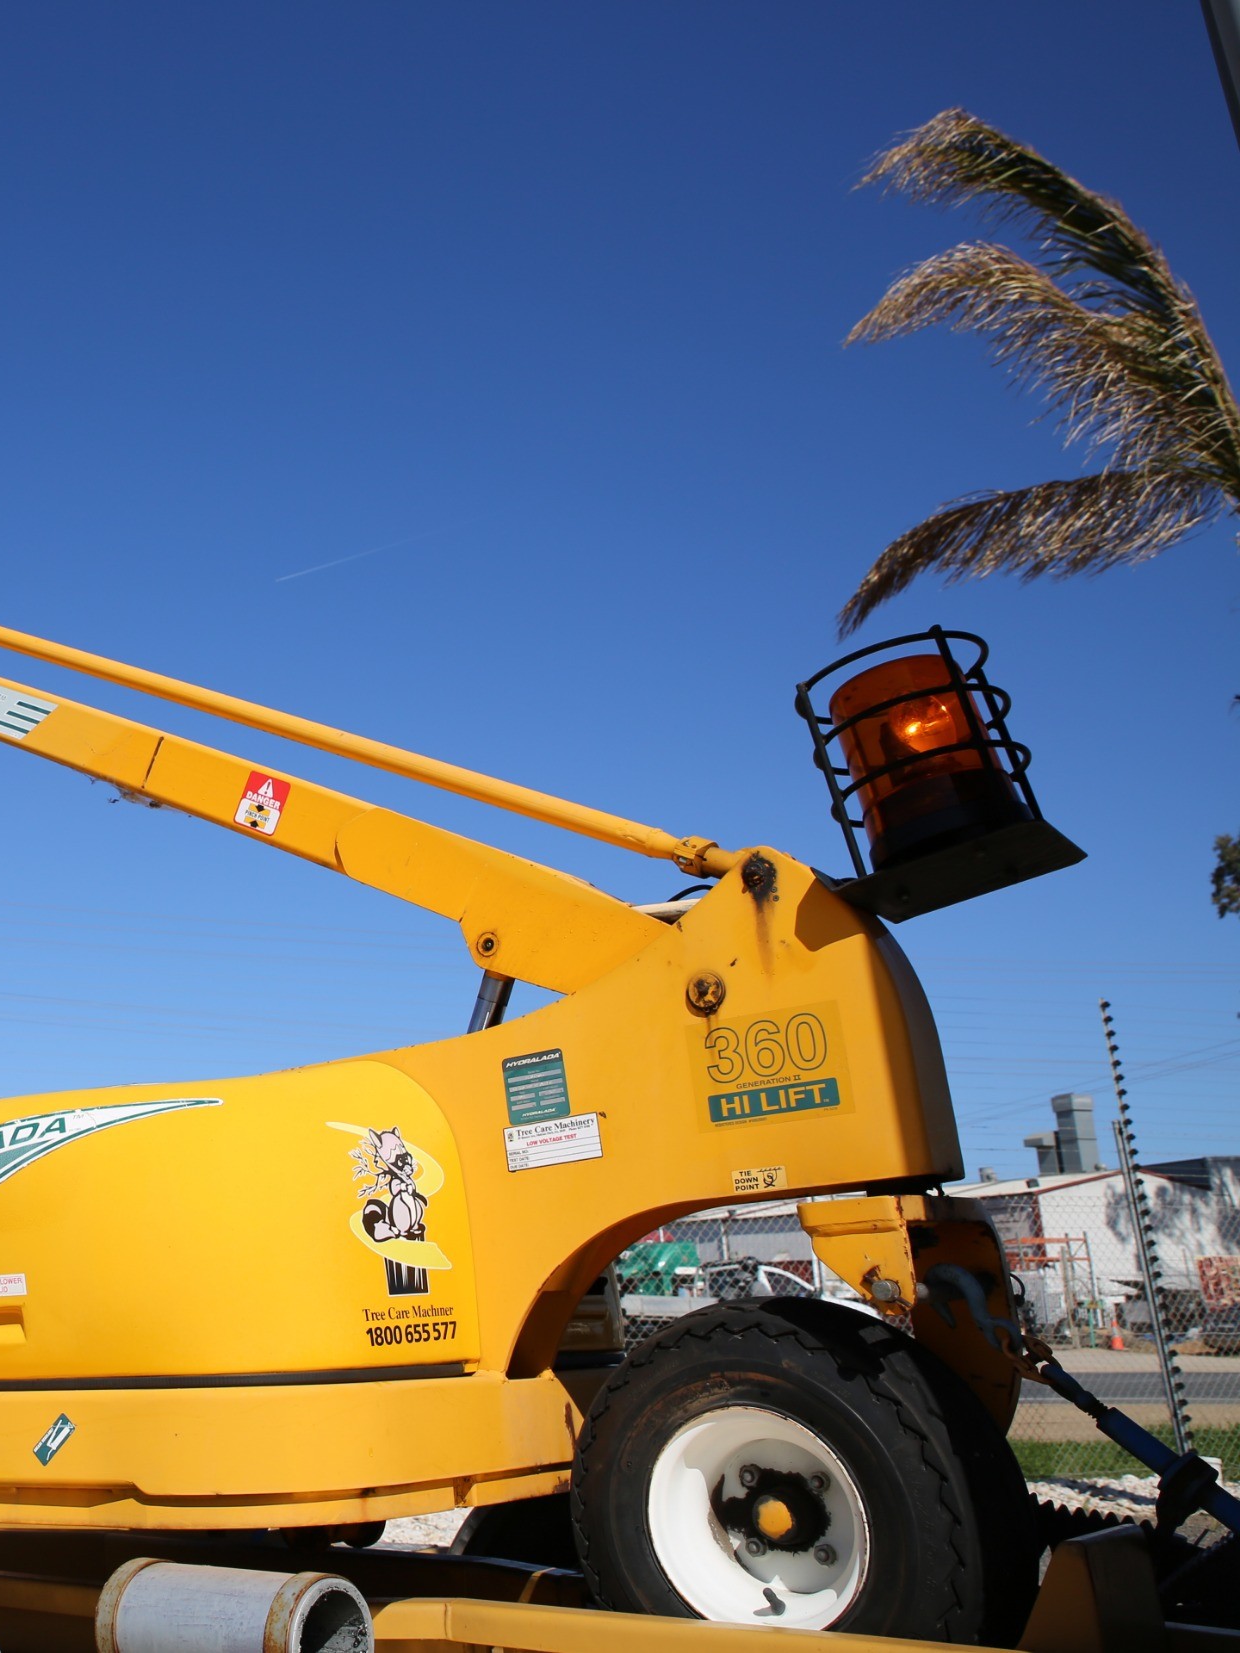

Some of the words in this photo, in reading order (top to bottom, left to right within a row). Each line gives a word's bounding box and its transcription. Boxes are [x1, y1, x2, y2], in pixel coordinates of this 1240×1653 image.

[246, 791, 280, 810] DANGER
[258, 814, 270, 823] POINT
[704, 1012, 827, 1083] 360
[506, 1053, 560, 1068] HYDRALADA
[736, 1076, 791, 1090] GENERATION
[720, 1095, 750, 1117] HI
[760, 1083, 826, 1111] LIFT
[516, 1128, 532, 1137] Tree
[535, 1125, 552, 1133] Care
[554, 1118, 594, 1130] Machinery
[539, 1136, 563, 1144] VOLTAGE
[735, 1176, 758, 1185] DOWN
[735, 1183, 759, 1192] POINT
[0, 1277, 23, 1285] LOWER
[362, 1308, 385, 1321] Tree
[388, 1306, 409, 1320] Care
[366, 1325, 402, 1346] 1800
[405, 1323, 430, 1344] 655
[433, 1321, 456, 1341] 577
